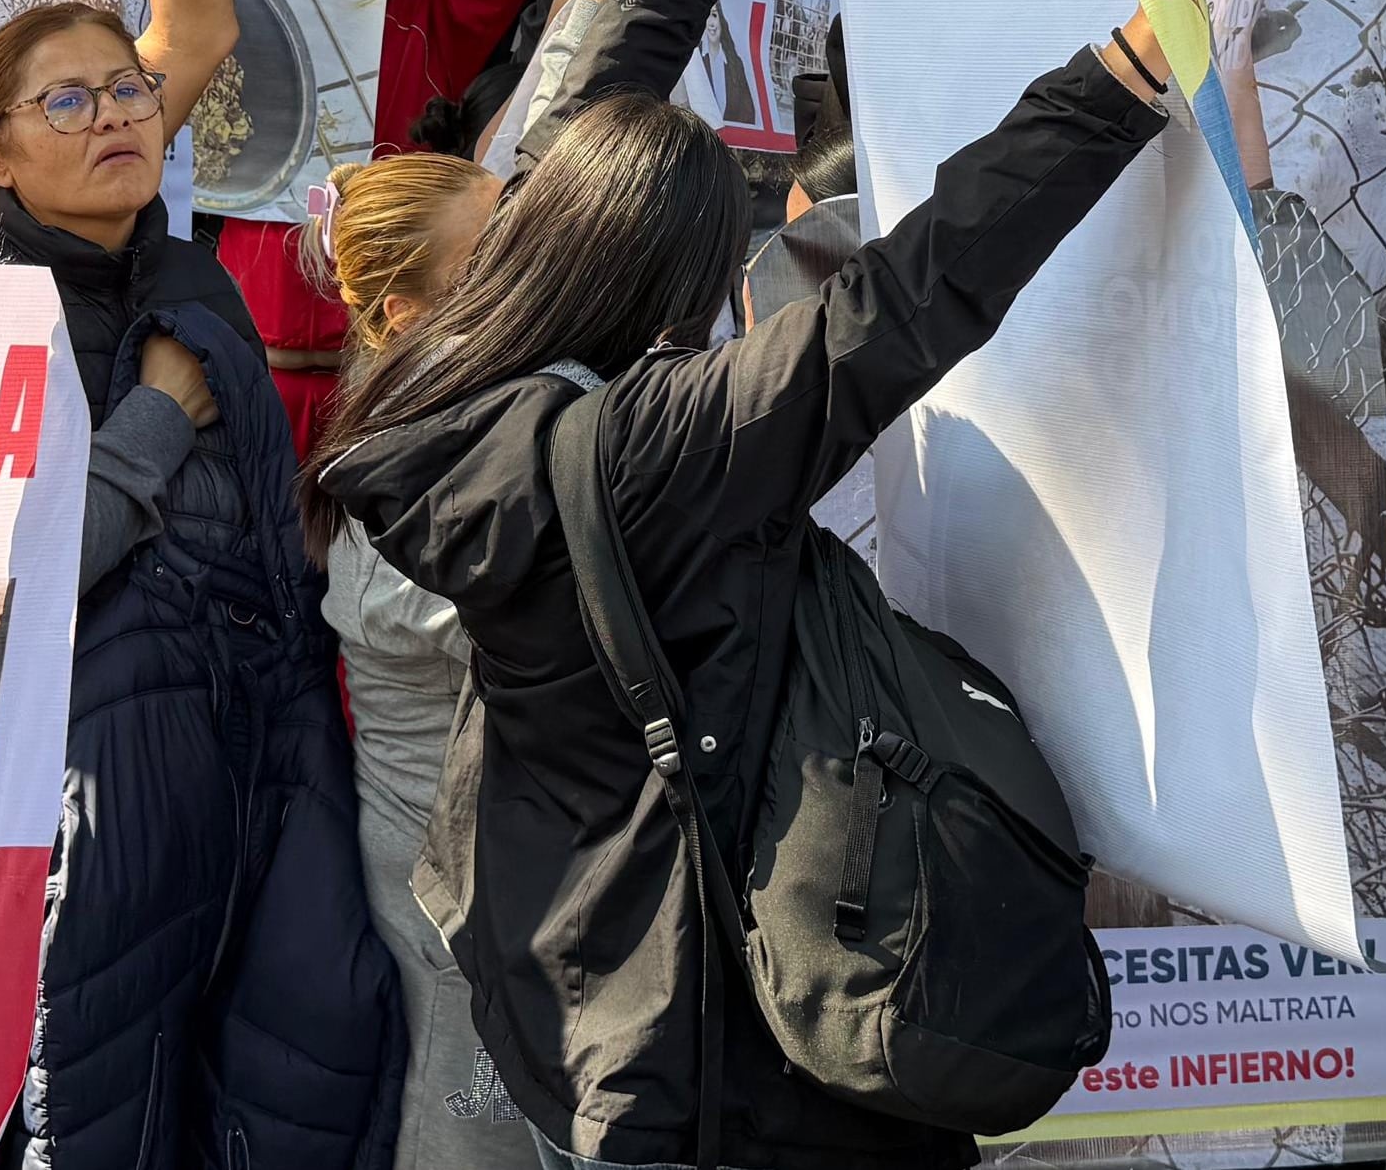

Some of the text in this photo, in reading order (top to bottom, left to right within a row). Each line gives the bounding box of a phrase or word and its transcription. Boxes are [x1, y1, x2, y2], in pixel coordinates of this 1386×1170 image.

[1102, 942, 1270, 986] CESITAS
[1150, 1000, 1209, 1028] NOS
[1216, 994, 1356, 1024] MALTRATA
[1082, 1046, 1355, 1093] este INFIERNO!
